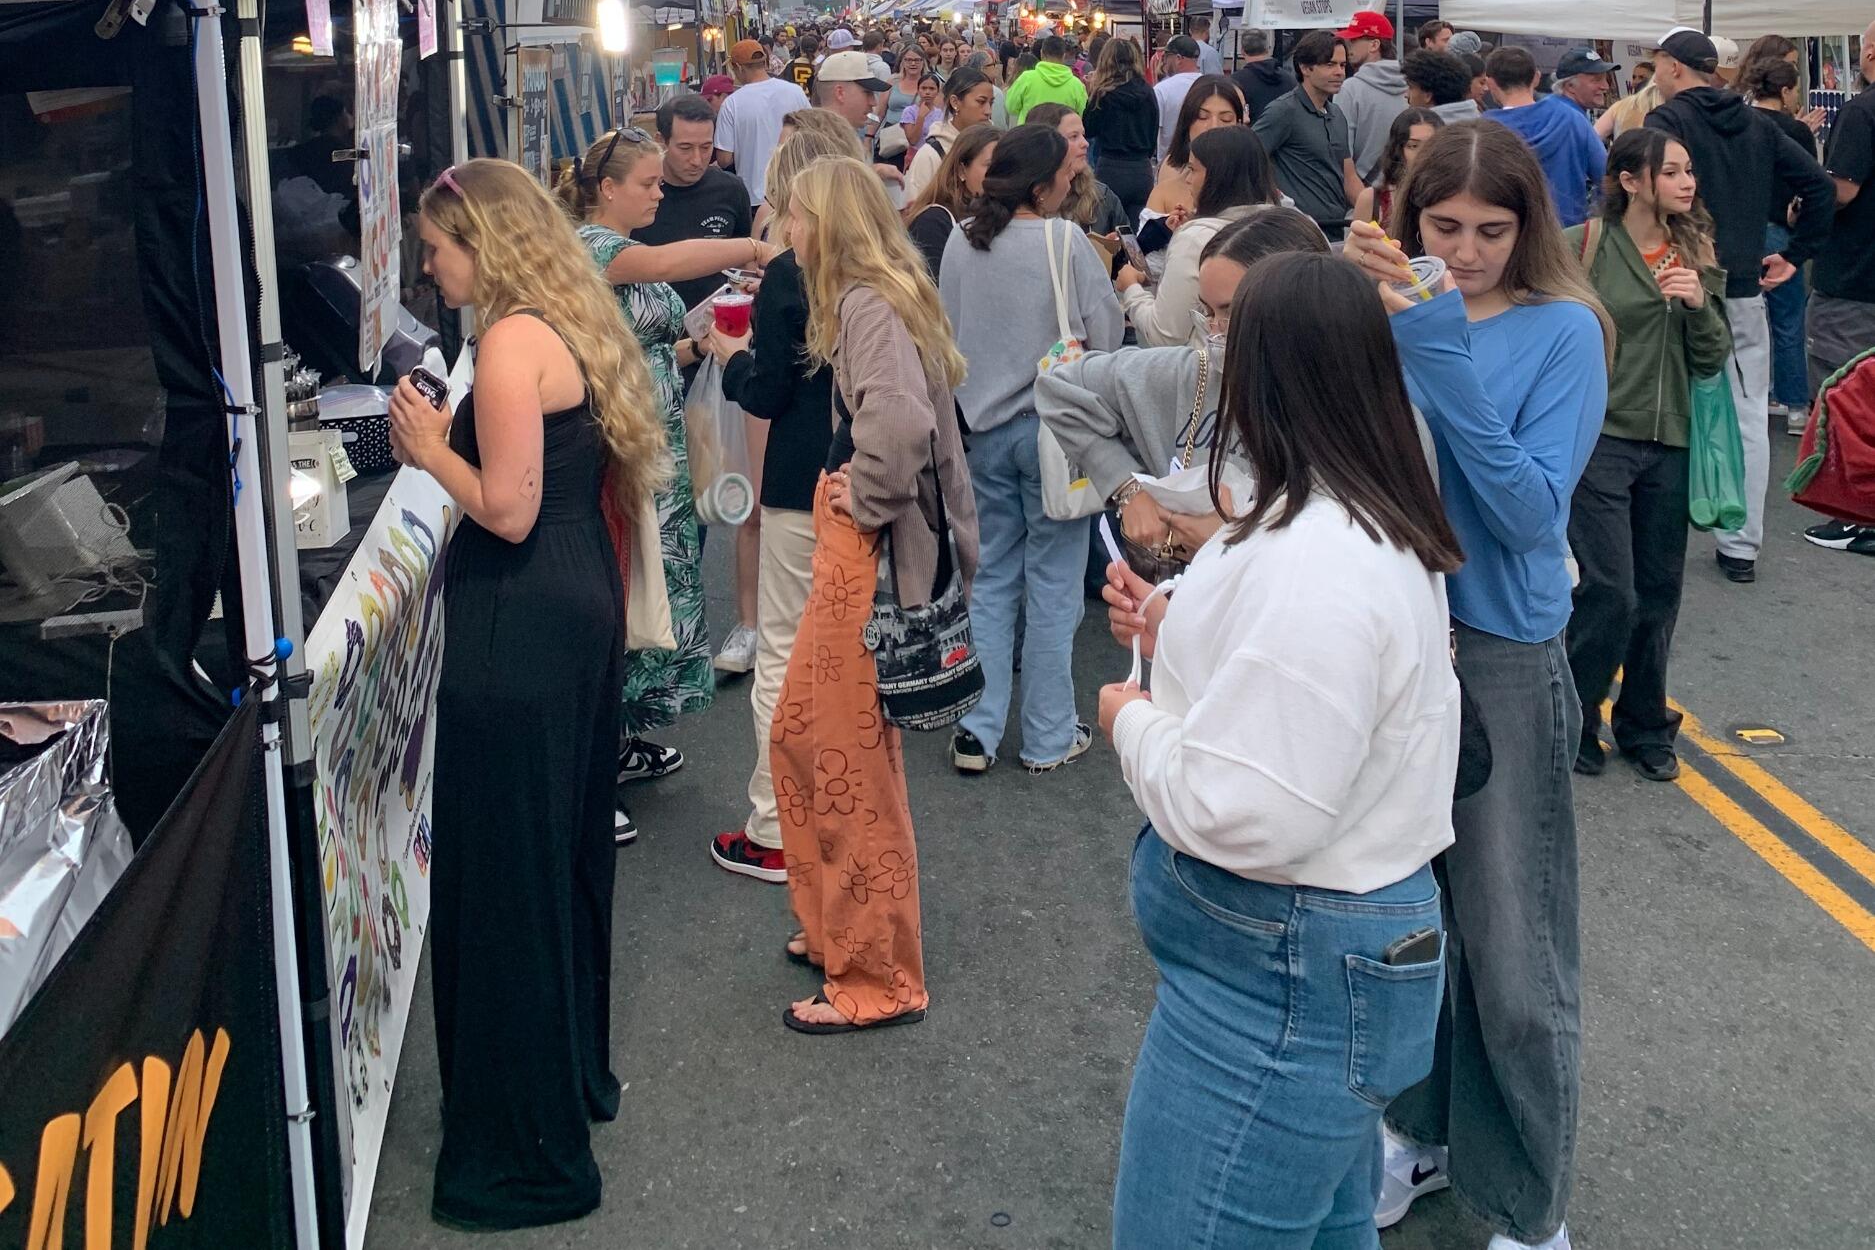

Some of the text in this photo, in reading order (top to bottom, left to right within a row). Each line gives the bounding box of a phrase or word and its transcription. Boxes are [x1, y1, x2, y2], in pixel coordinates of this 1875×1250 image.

[1301, 0, 1332, 14] VEGAN STOPS
[416, 381, 437, 399] 6:06
[298, 460, 311, 468] THE
[898, 678, 928, 689] GERMANY
[928, 668, 956, 683] GERMANY
[956, 656, 978, 673] GERMANY
